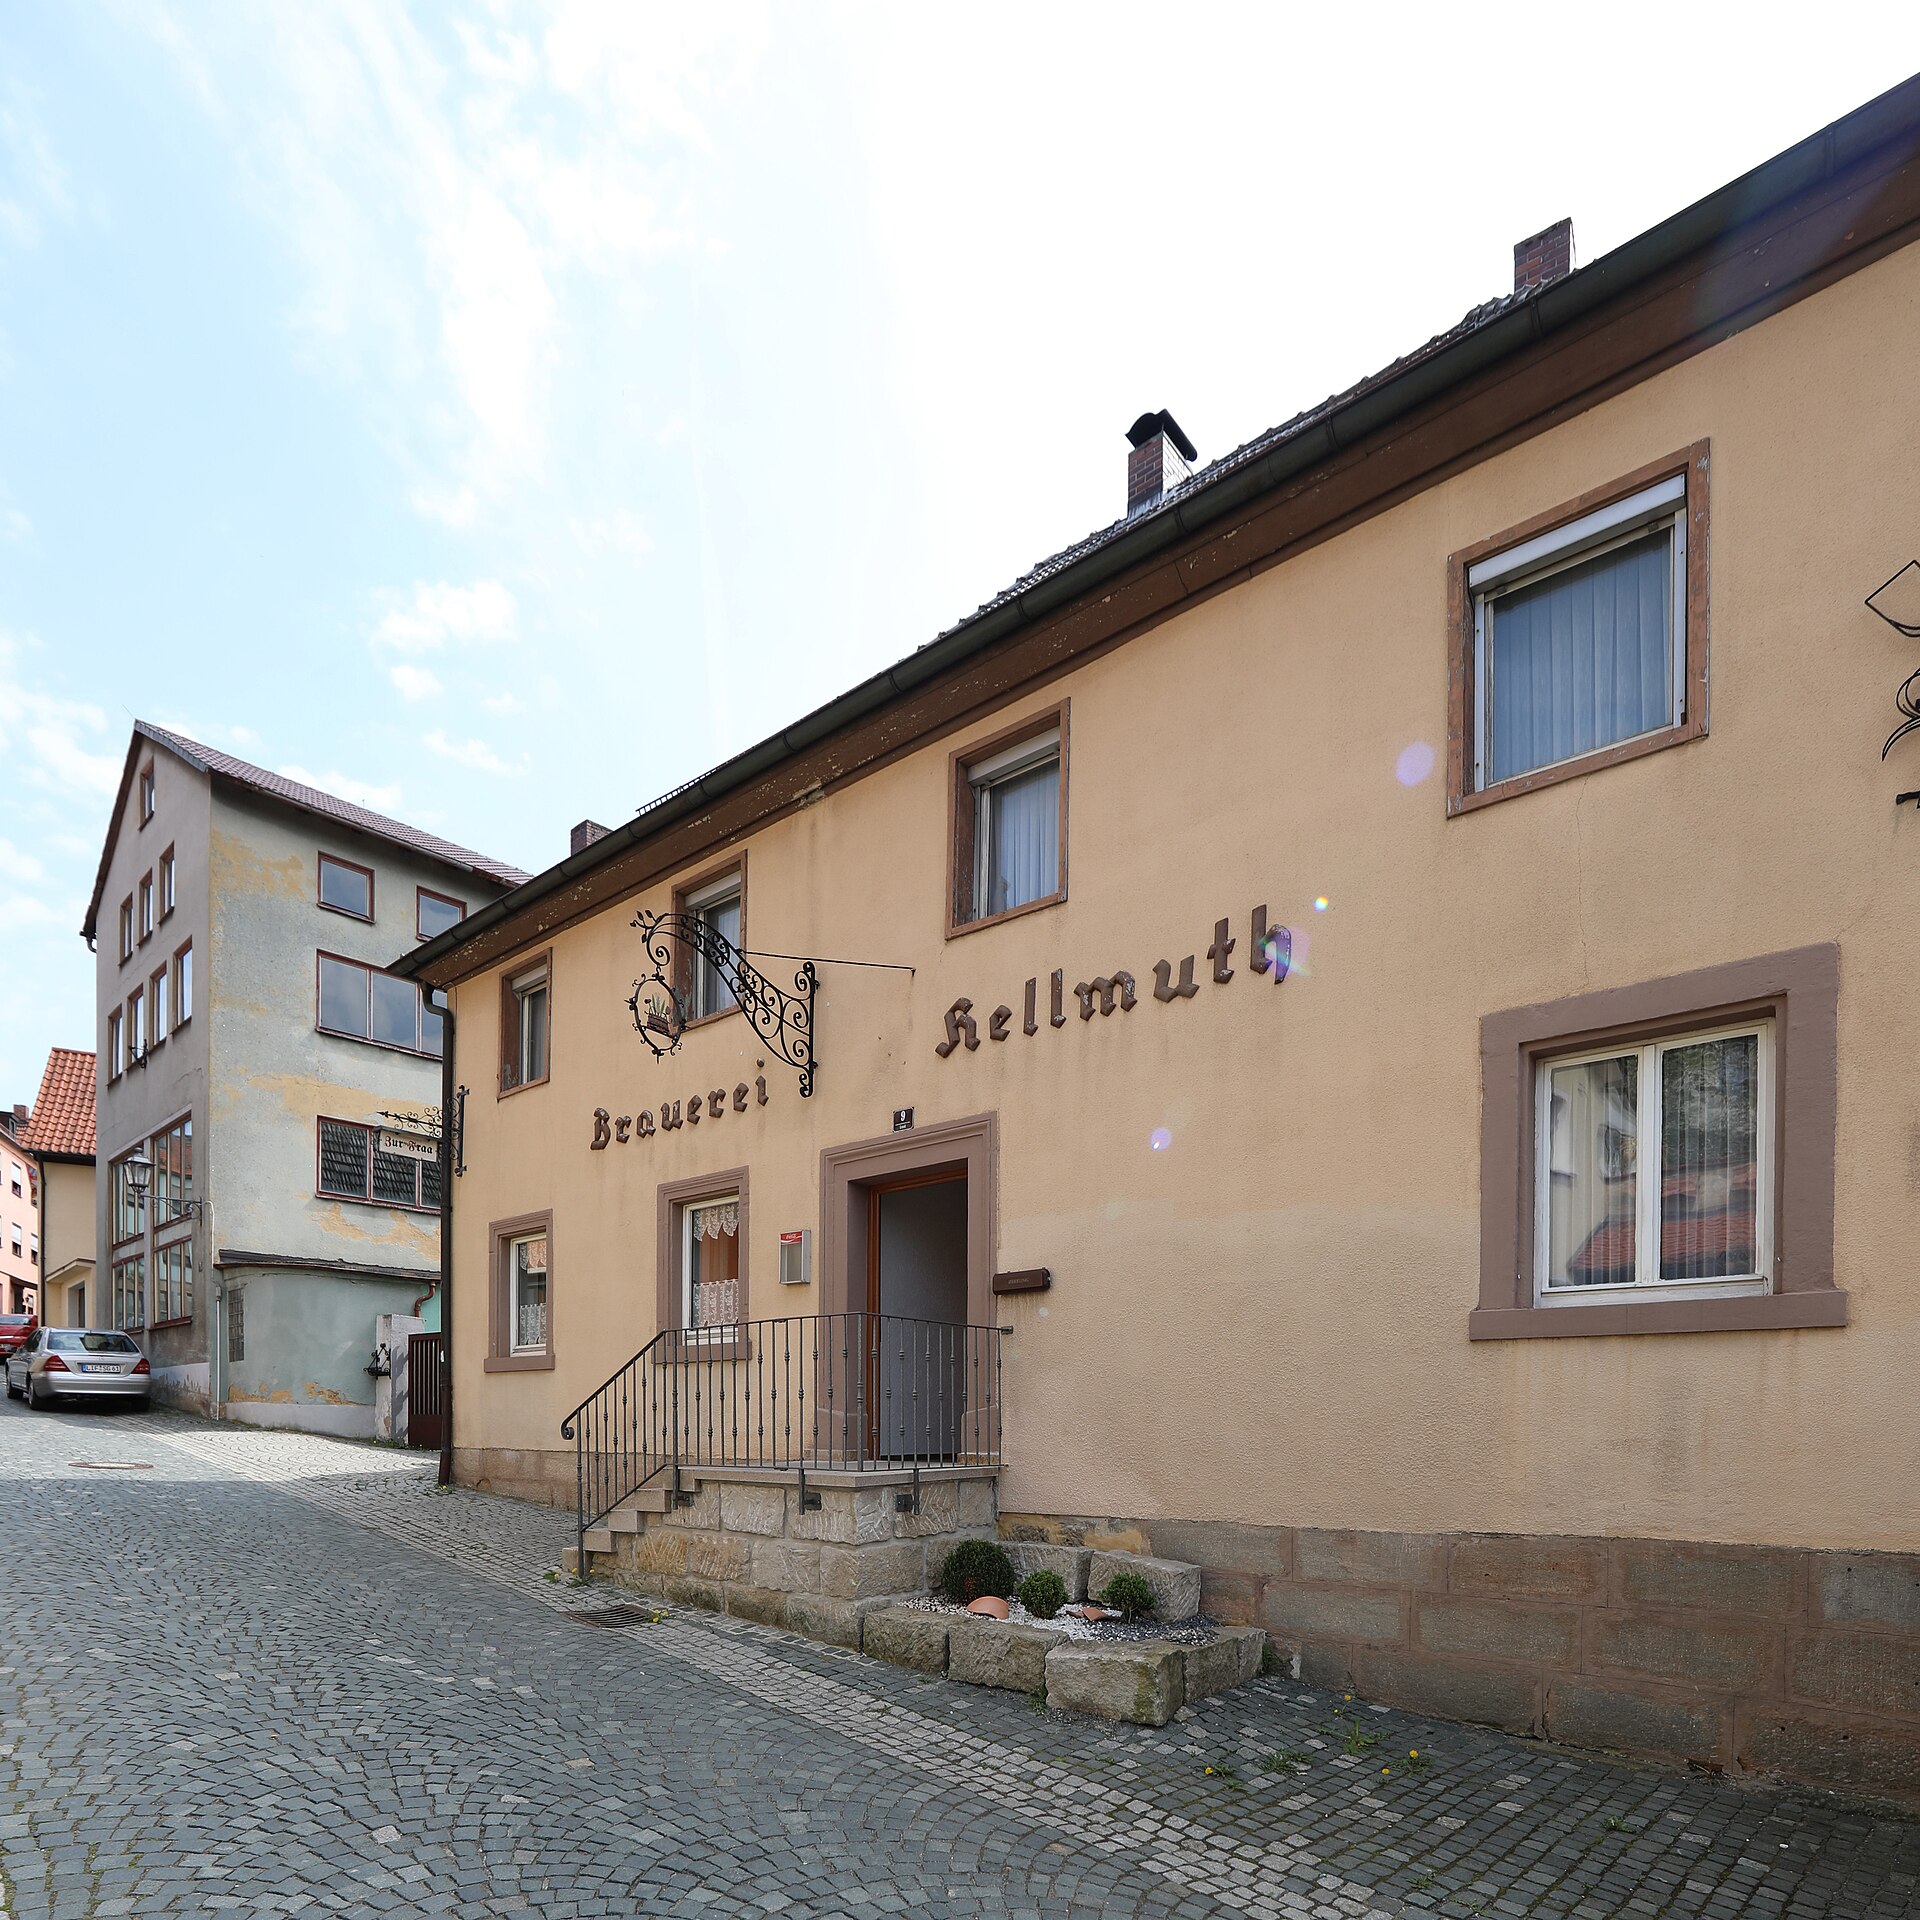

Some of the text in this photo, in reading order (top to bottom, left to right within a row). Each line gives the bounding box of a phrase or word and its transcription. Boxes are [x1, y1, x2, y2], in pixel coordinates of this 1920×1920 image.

[589, 1058, 770, 1151] Brauerei
[900, 1110, 906, 1122] 9
[385, 1135, 404, 1148] Zur
